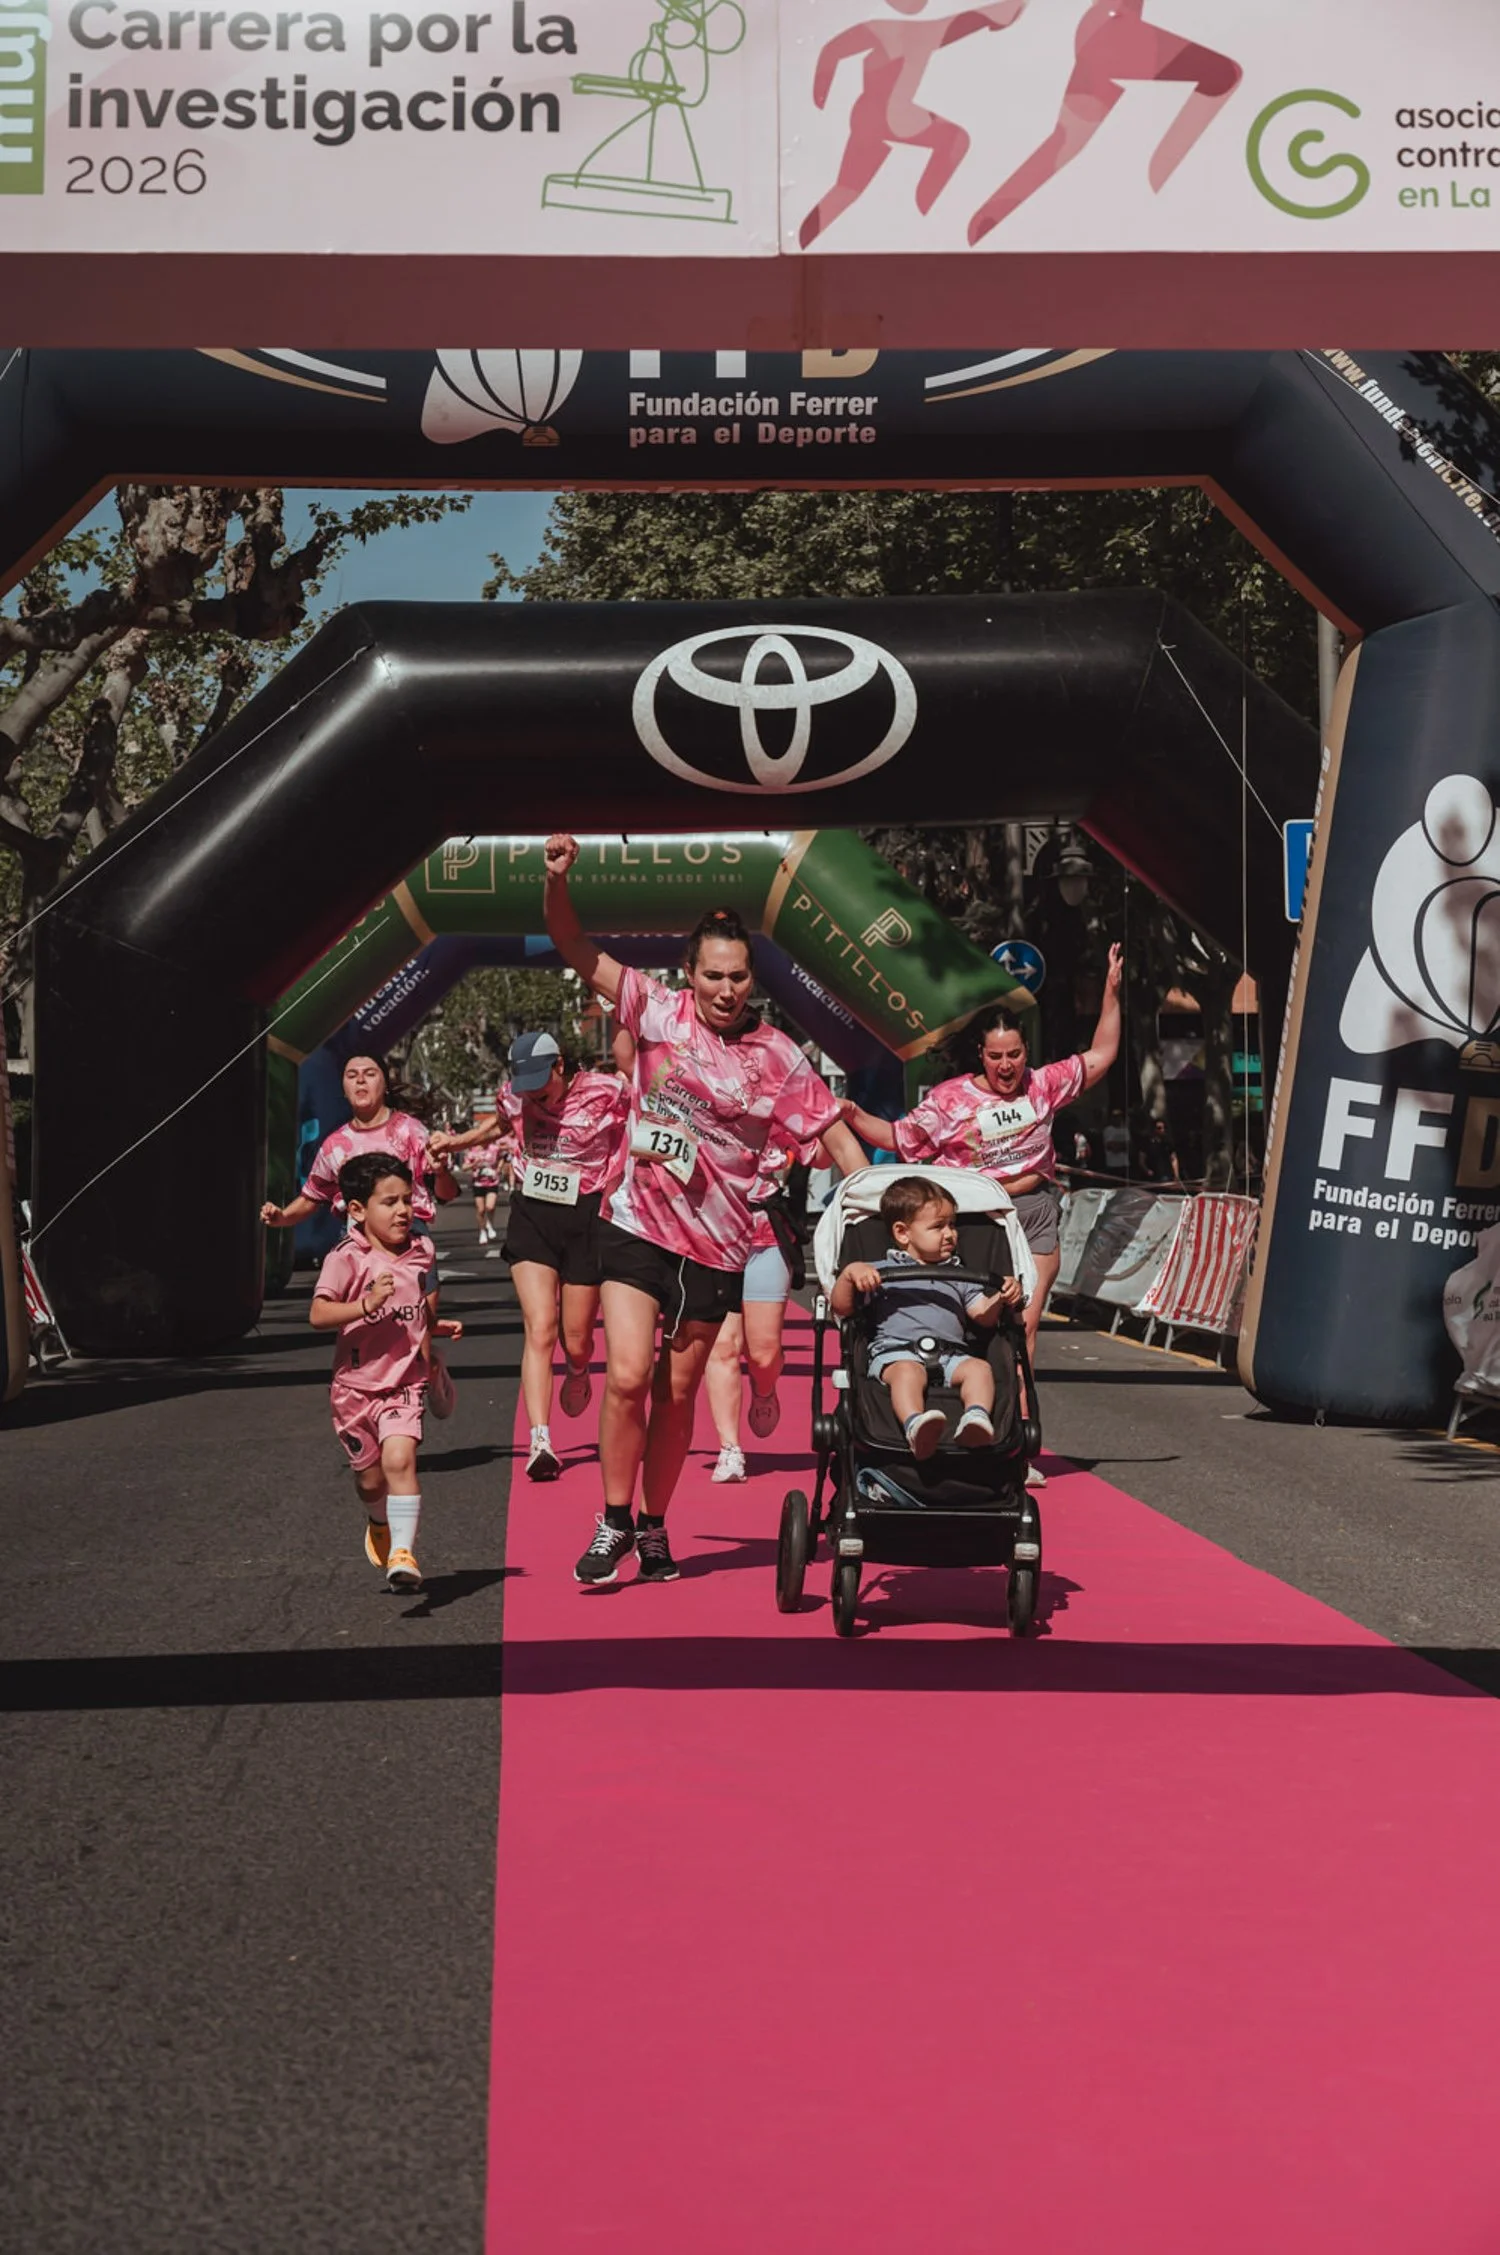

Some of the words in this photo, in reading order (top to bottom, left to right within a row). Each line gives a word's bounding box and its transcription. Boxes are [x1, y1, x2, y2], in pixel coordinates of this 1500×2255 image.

[68, 0, 345, 52] Carrera
[369, 12, 491, 67] por
[512, 0, 577, 55] la
[67, 72, 561, 147] investigación
[65, 148, 208, 195] 2026
[1398, 187, 1439, 208] en
[1450, 180, 1490, 208] La
[629, 390, 779, 416] Fundación
[790, 391, 878, 416] Ferrer
[629, 425, 697, 447] para
[714, 422, 740, 444] el
[758, 422, 876, 447] Deporte
[508, 838, 742, 864] PILLOS
[792, 893, 924, 1029] PITILLOS
[664, 1077, 711, 1109] Carrera
[992, 1108, 1022, 1126] 144
[1317, 1077, 1500, 1188] FFD
[533, 1171, 569, 1193] 9153
[1313, 1177, 1435, 1218] Fundación
[1309, 1209, 1363, 1235] para
[1375, 1218, 1400, 1240] el
